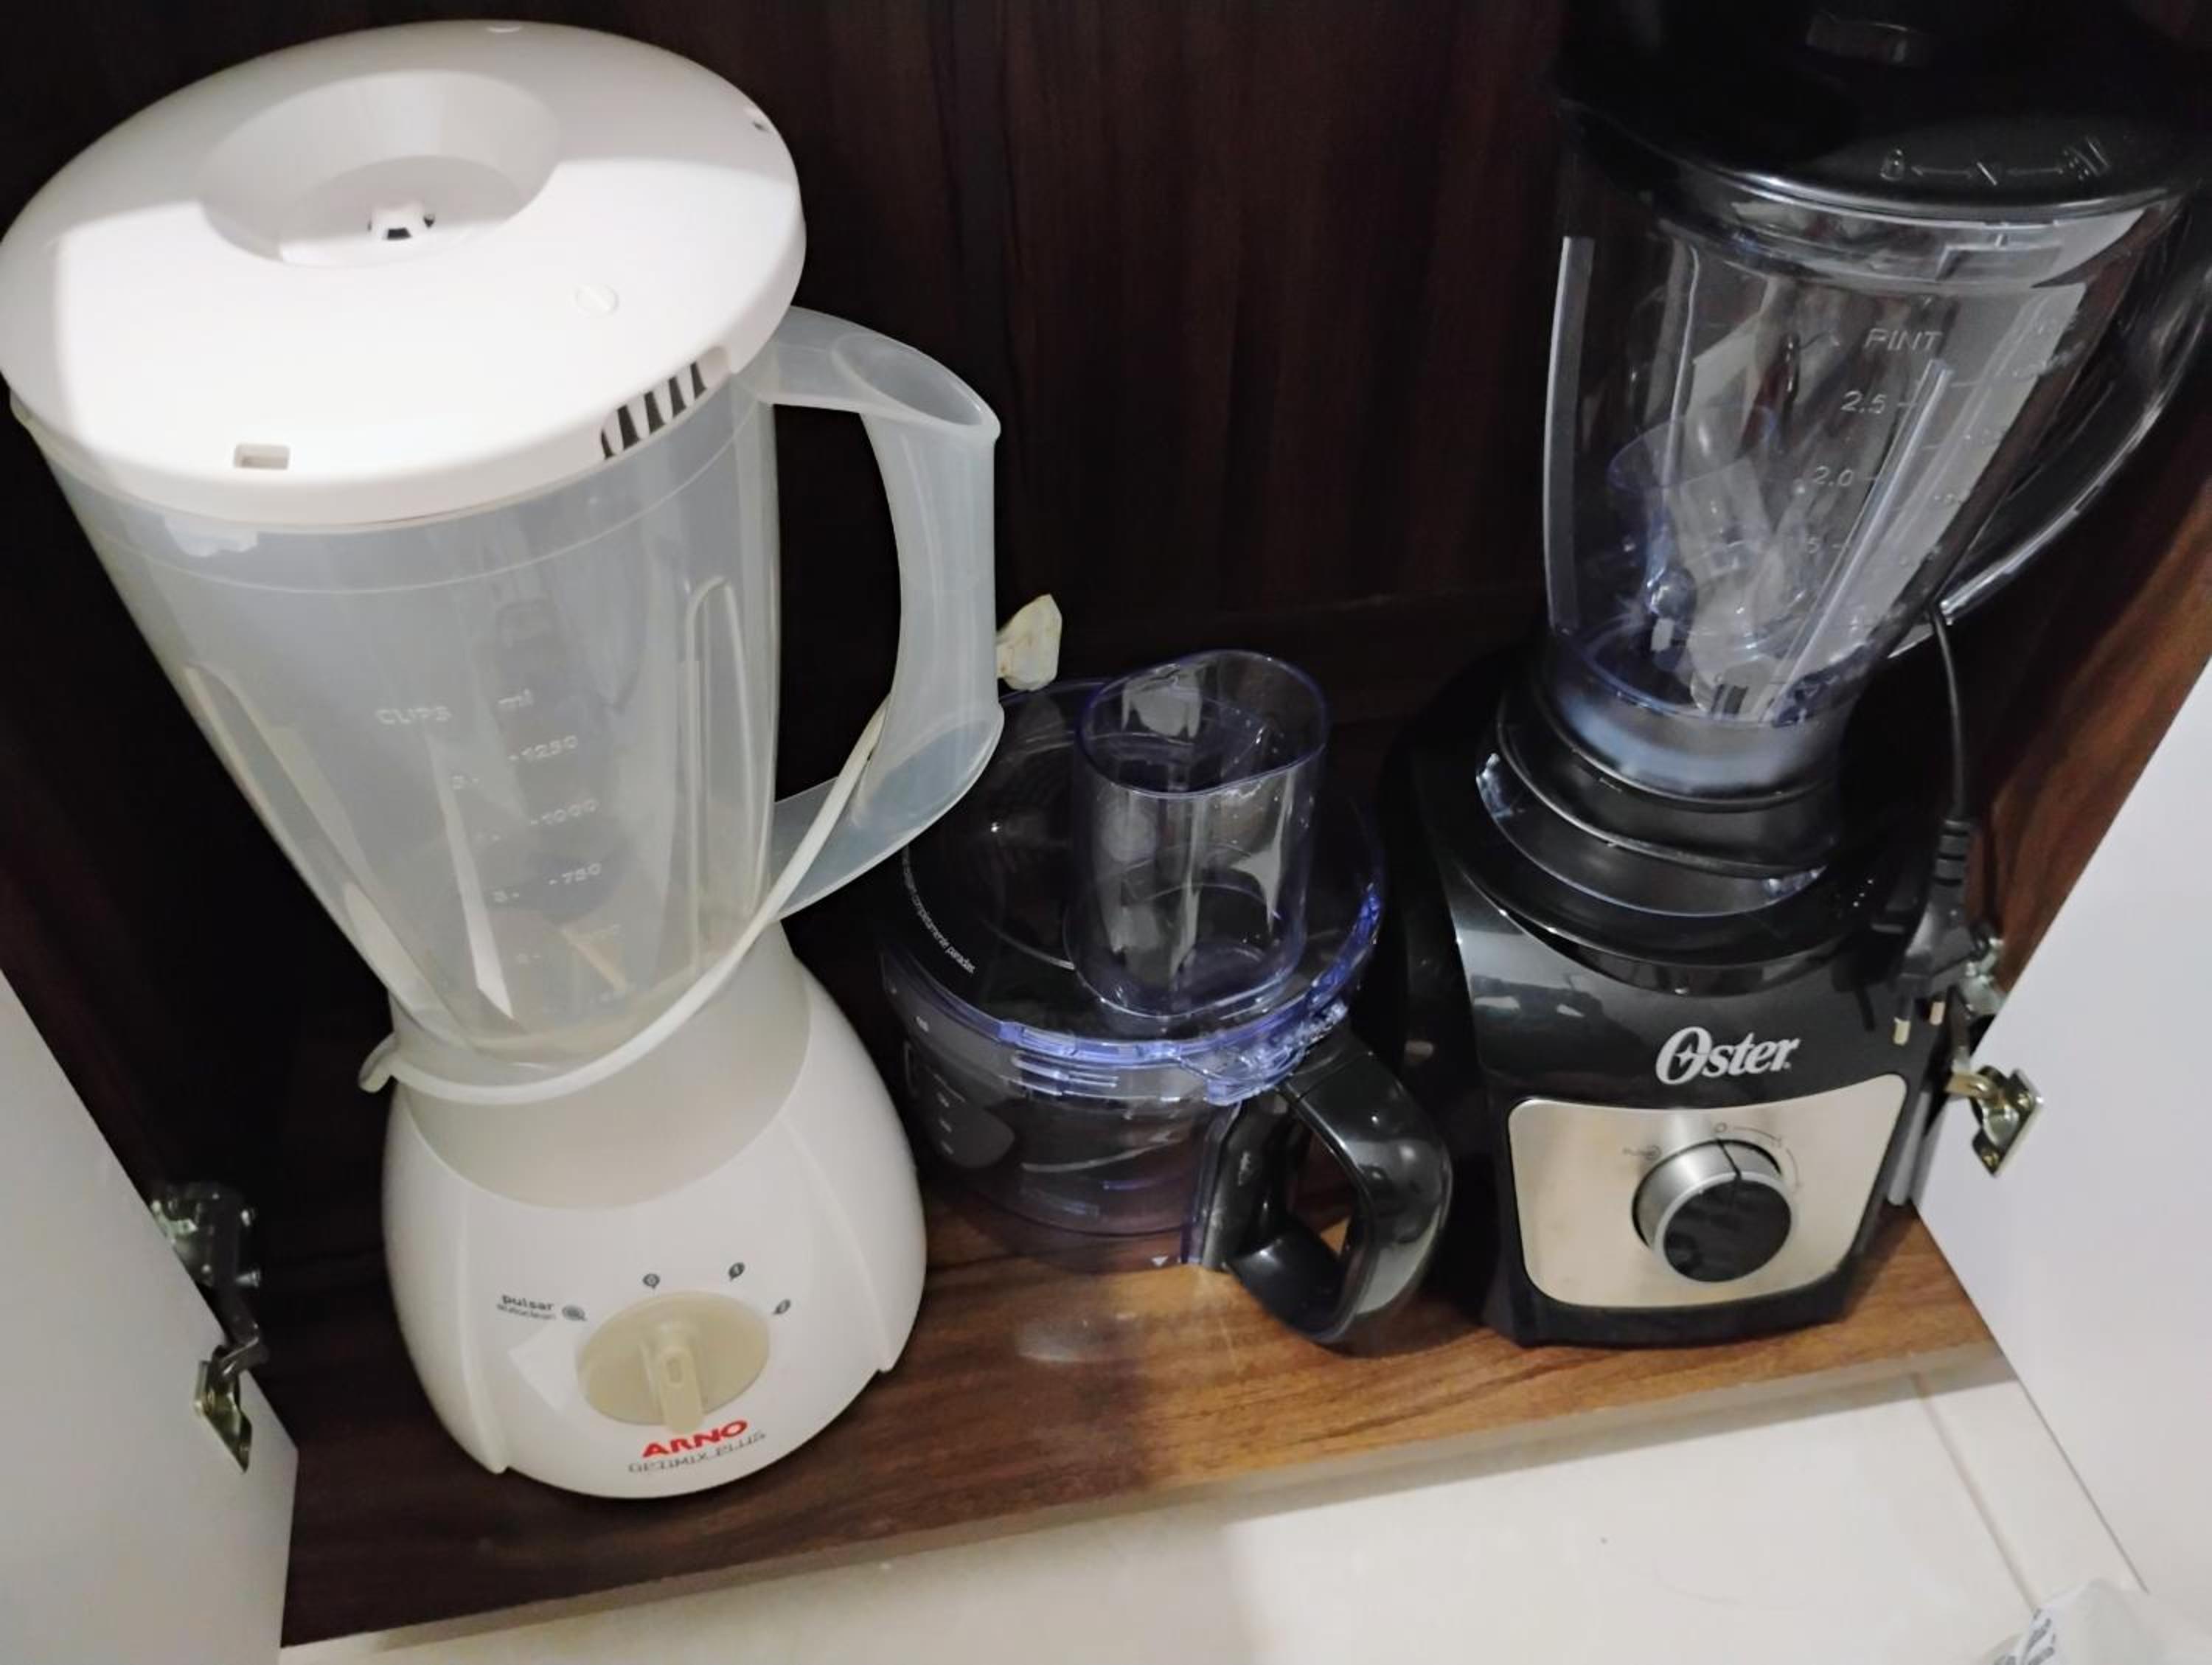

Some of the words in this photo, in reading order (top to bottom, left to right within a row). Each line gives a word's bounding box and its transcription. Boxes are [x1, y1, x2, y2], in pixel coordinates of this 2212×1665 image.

[1863, 327, 1944, 351] PINT
[1840, 389, 1887, 414] 2.5
[1813, 465, 1854, 487] 2.0
[375, 706, 452, 724] CUPS
[520, 735, 579, 762] 1250
[1656, 1026, 1801, 1085] Oster
[501, 1294, 554, 1310] pulsar
[642, 1419, 748, 1459] ARNO
[714, 1429, 767, 1457] PLUS
